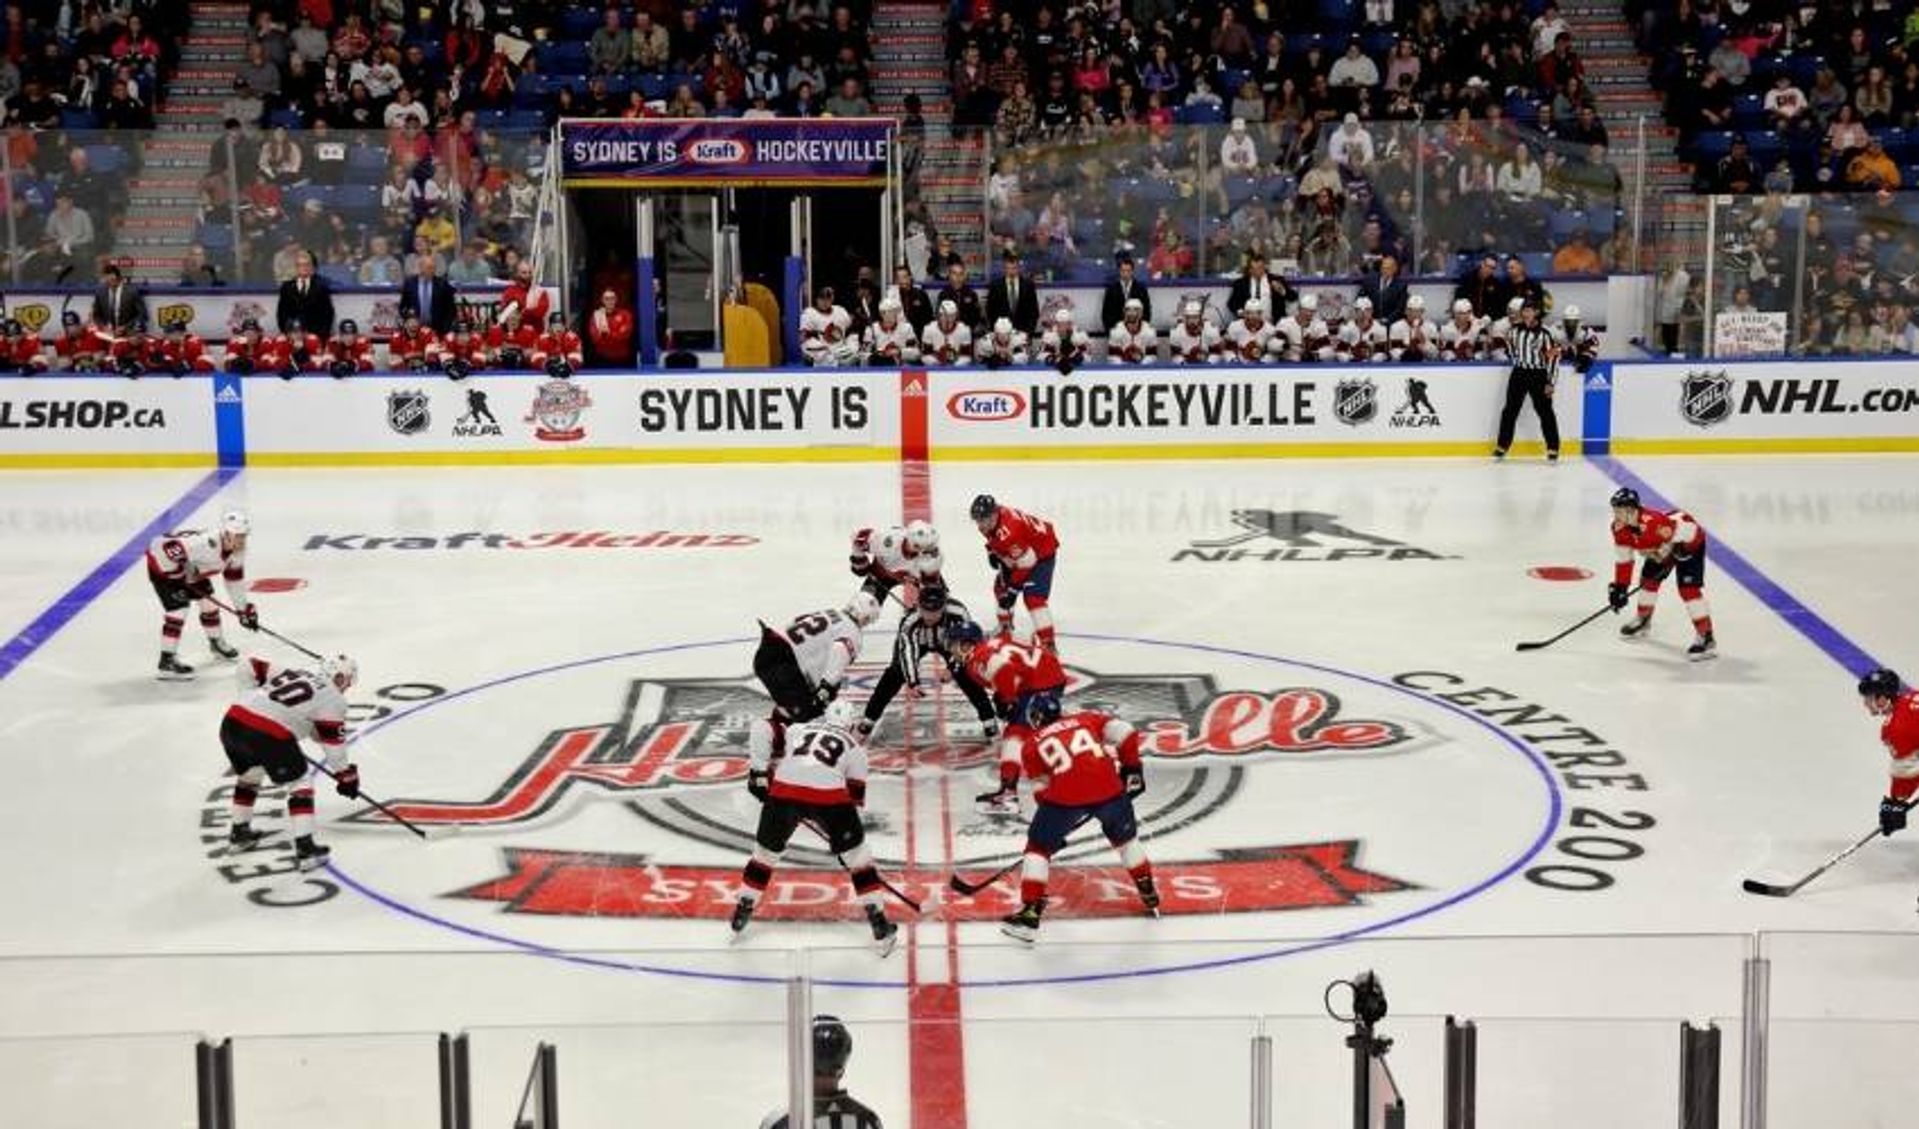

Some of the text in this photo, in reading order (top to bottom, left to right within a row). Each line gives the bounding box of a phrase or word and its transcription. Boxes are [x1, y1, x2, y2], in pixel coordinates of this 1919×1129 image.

[573, 139, 887, 163] SYDNEY IS Kraft HOCKEYVILLE
[639, 386, 811, 432] SYDNEY
[831, 385, 868, 430] IS
[963, 382, 1316, 429] Kraft HOCKEYVILLE
[1389, 415, 1442, 428] NHLPA
[452, 425, 504, 437] NHLPA
[1170, 547, 1464, 562] NHLPA
[787, 614, 828, 646] 12
[792, 732, 846, 768] 19
[1037, 726, 1105, 775] 94
[1391, 671, 1657, 892] CENTRE 200
